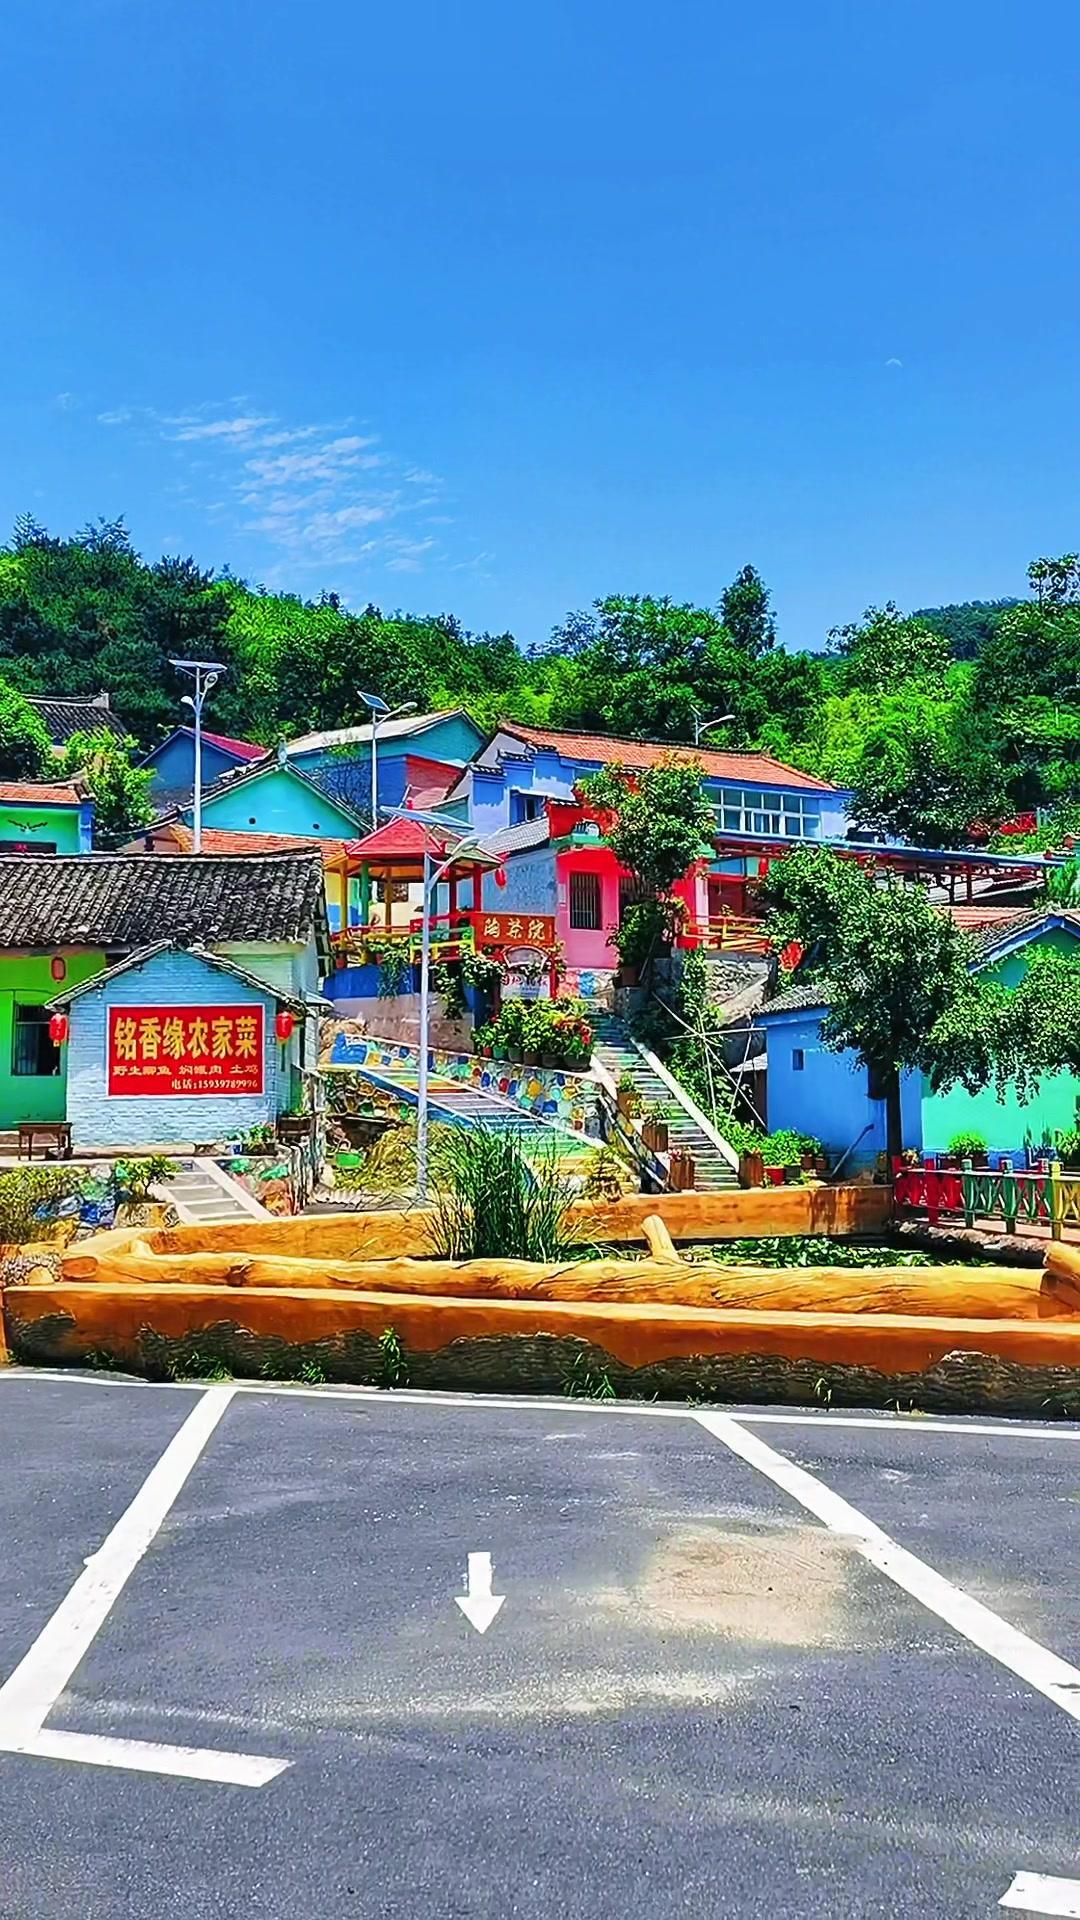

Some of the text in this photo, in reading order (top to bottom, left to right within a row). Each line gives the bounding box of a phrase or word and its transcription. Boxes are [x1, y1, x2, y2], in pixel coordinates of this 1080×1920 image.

[114, 1016, 258, 1060] 铭香缘农家菜
